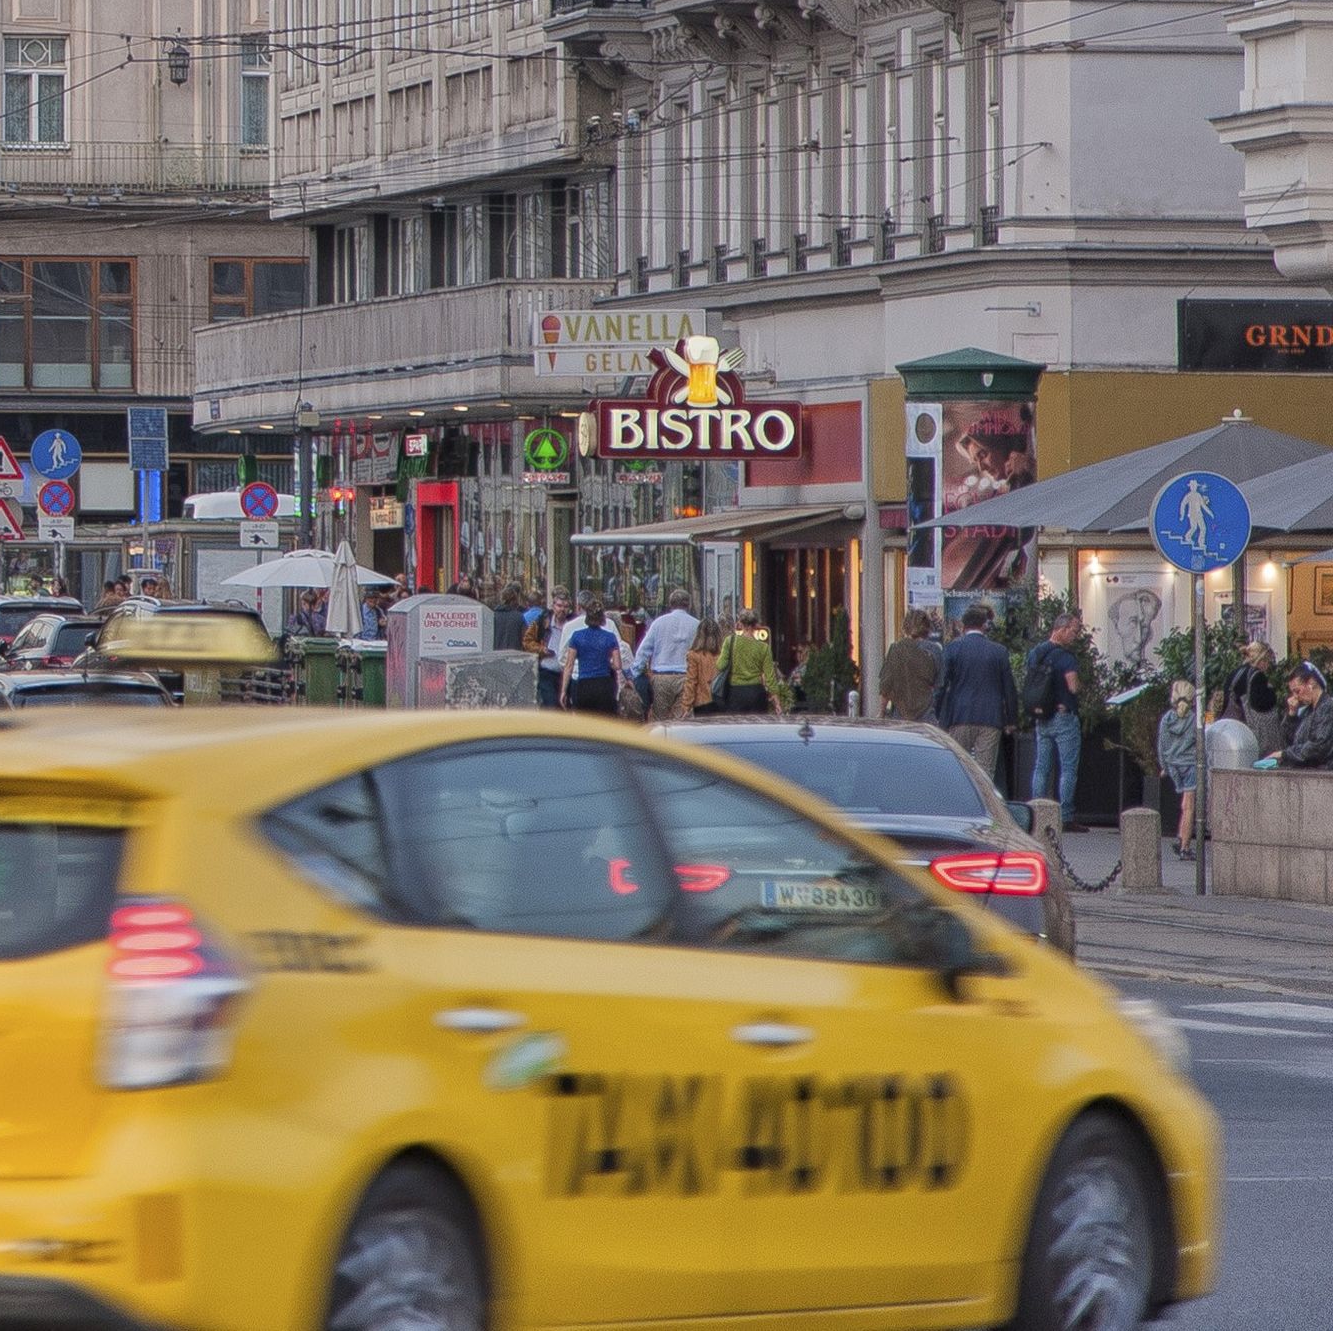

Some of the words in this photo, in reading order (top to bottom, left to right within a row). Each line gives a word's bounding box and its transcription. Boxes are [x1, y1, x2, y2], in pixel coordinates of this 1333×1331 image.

[565, 315, 694, 341] VANELLA
[610, 409, 795, 451] BISTRO
[424, 620, 442, 628] UND
[444, 620, 478, 628] SCHUHE
[425, 612, 477, 620] ALTKLEIDER
